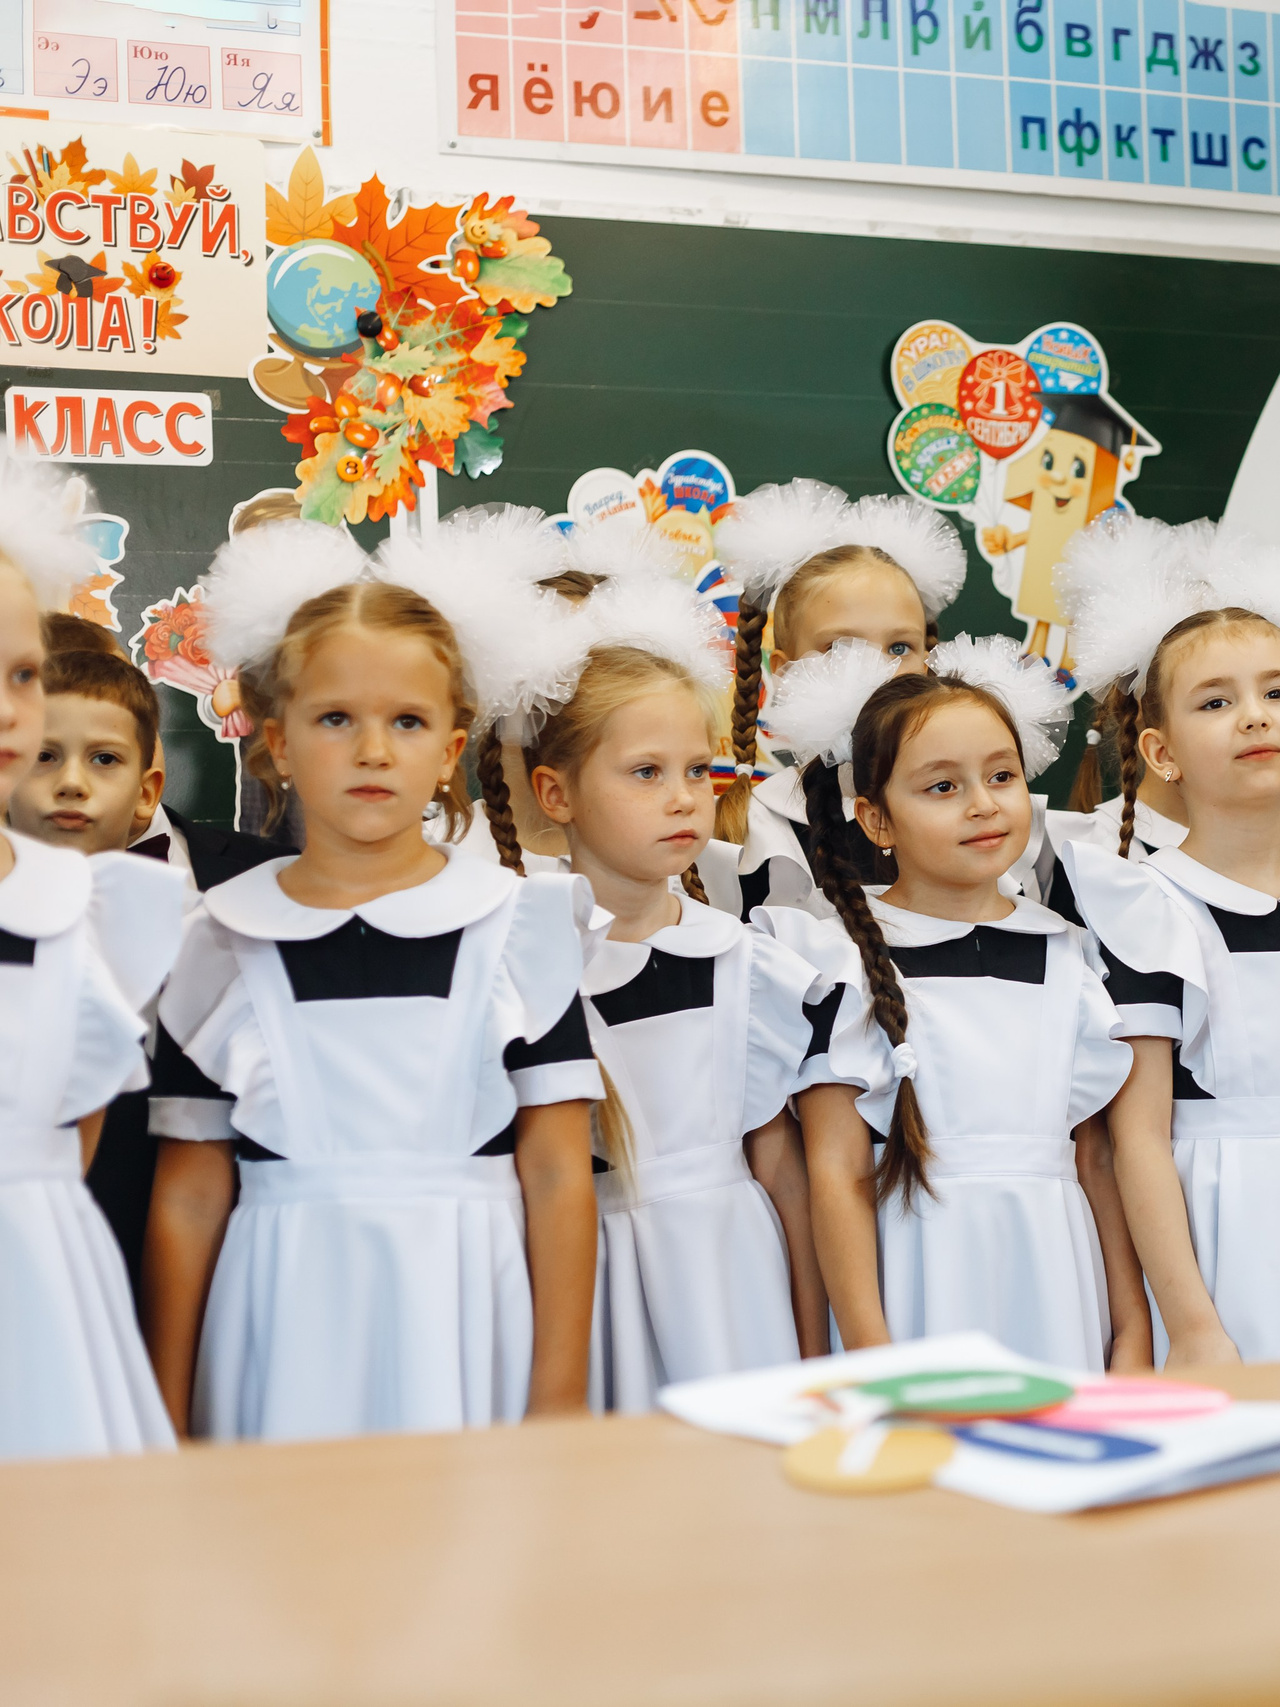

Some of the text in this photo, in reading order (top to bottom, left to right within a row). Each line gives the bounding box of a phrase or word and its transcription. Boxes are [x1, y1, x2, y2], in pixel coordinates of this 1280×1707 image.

[1065, 22, 1093, 58] в
[1112, 28, 1131, 61] г
[1146, 32, 1179, 76] д
[1188, 36, 1225, 73] ж
[467, 62, 731, 127] я ё ю и е
[1021, 116, 1047, 151] п
[1058, 108, 1100, 167] ф
[1115, 123, 1139, 160] к
[1152, 128, 1176, 163] т
[1191, 132, 1229, 168] ш
[1243, 136, 1267, 172] с
[0, 183, 254, 264] ВСТВУЙ,
[901, 332, 949, 362] УРА!
[13, 394, 206, 457] КЛАСС
[990, 381, 1008, 415] 1
[673, 486, 716, 505] ШКОЛА
